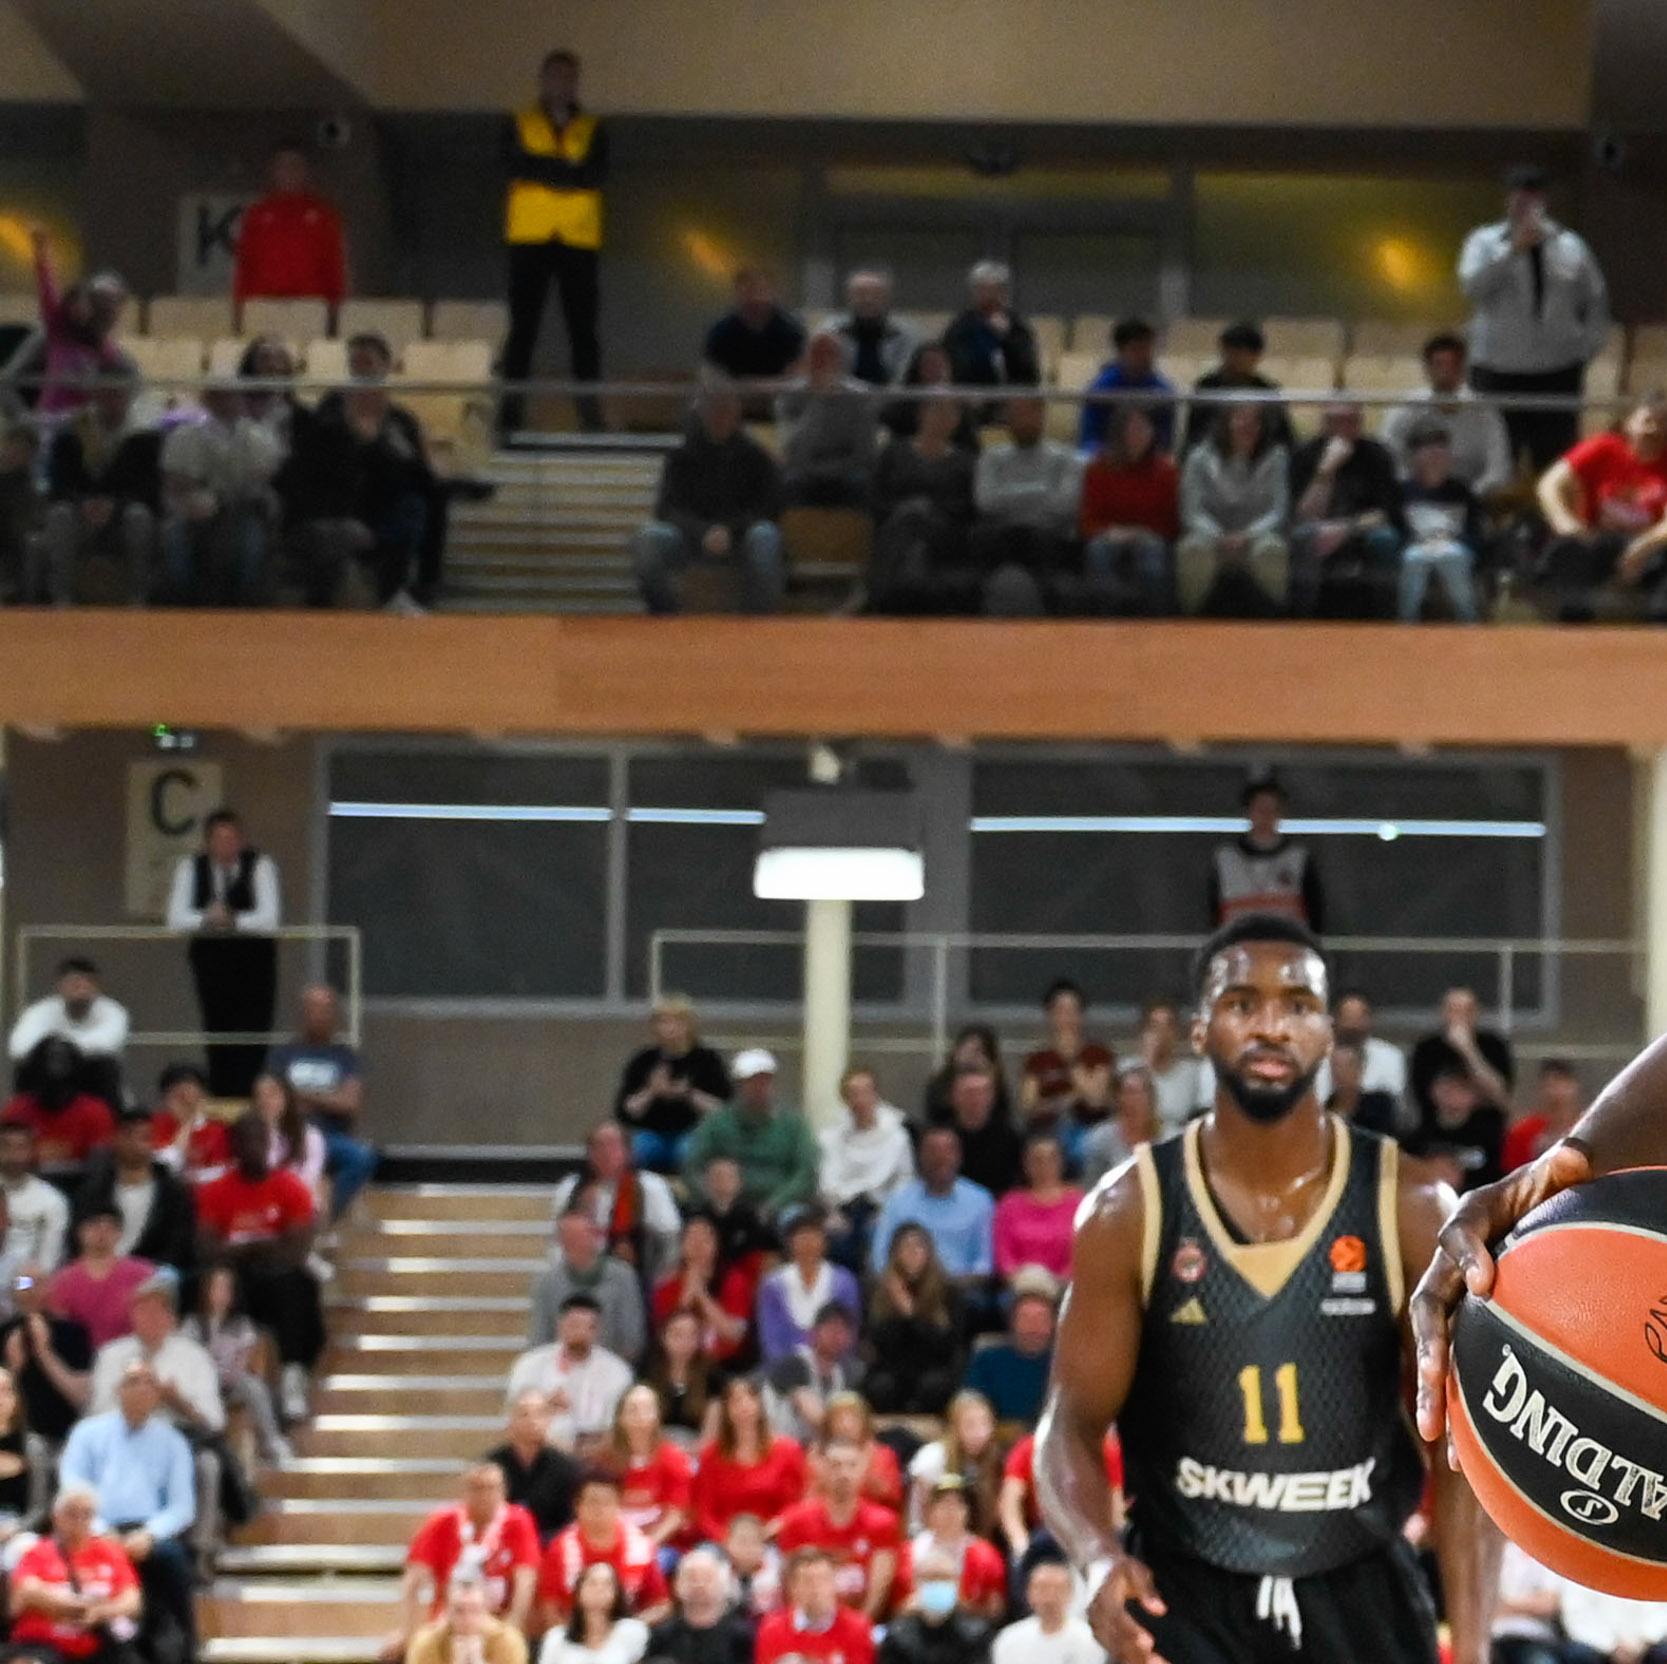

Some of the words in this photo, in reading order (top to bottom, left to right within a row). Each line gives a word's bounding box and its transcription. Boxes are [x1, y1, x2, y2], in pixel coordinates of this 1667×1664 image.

[151, 769, 199, 836] C
[1239, 1362, 1304, 1445] 11
[1176, 1456, 1376, 1512] SKWEEK
